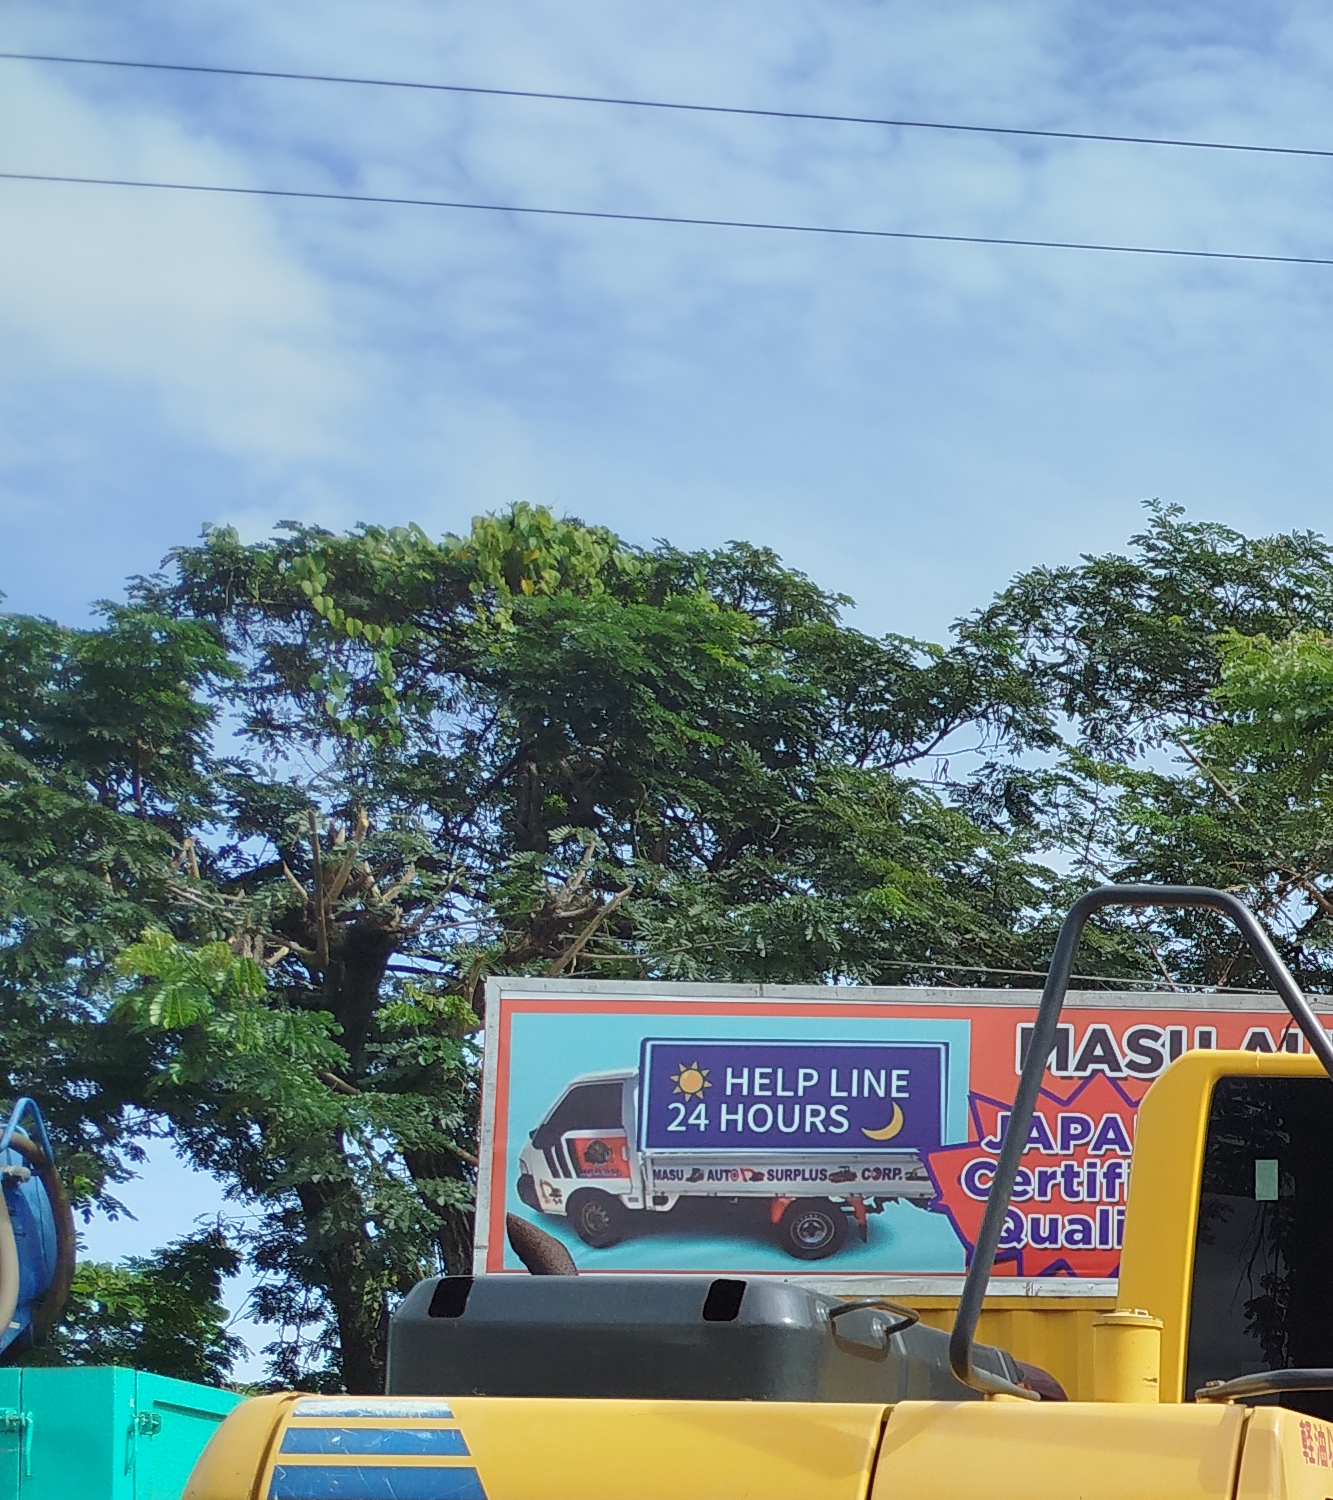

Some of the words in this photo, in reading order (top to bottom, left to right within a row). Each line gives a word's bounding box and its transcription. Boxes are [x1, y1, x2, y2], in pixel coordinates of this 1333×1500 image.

[726, 1066, 819, 1097] HELP
[830, 1068, 910, 1099] LINE
[667, 1102, 710, 1133] 24
[719, 1103, 849, 1134] HOURS
[981, 1112, 1134, 1155] JAPA
[652, 1168, 684, 1181] MASU
[706, 1169, 739, 1182] AUTO
[766, 1168, 828, 1182] SURPLUS
[961, 1158, 1131, 1201] Certif
[997, 1206, 1126, 1249] Quali
